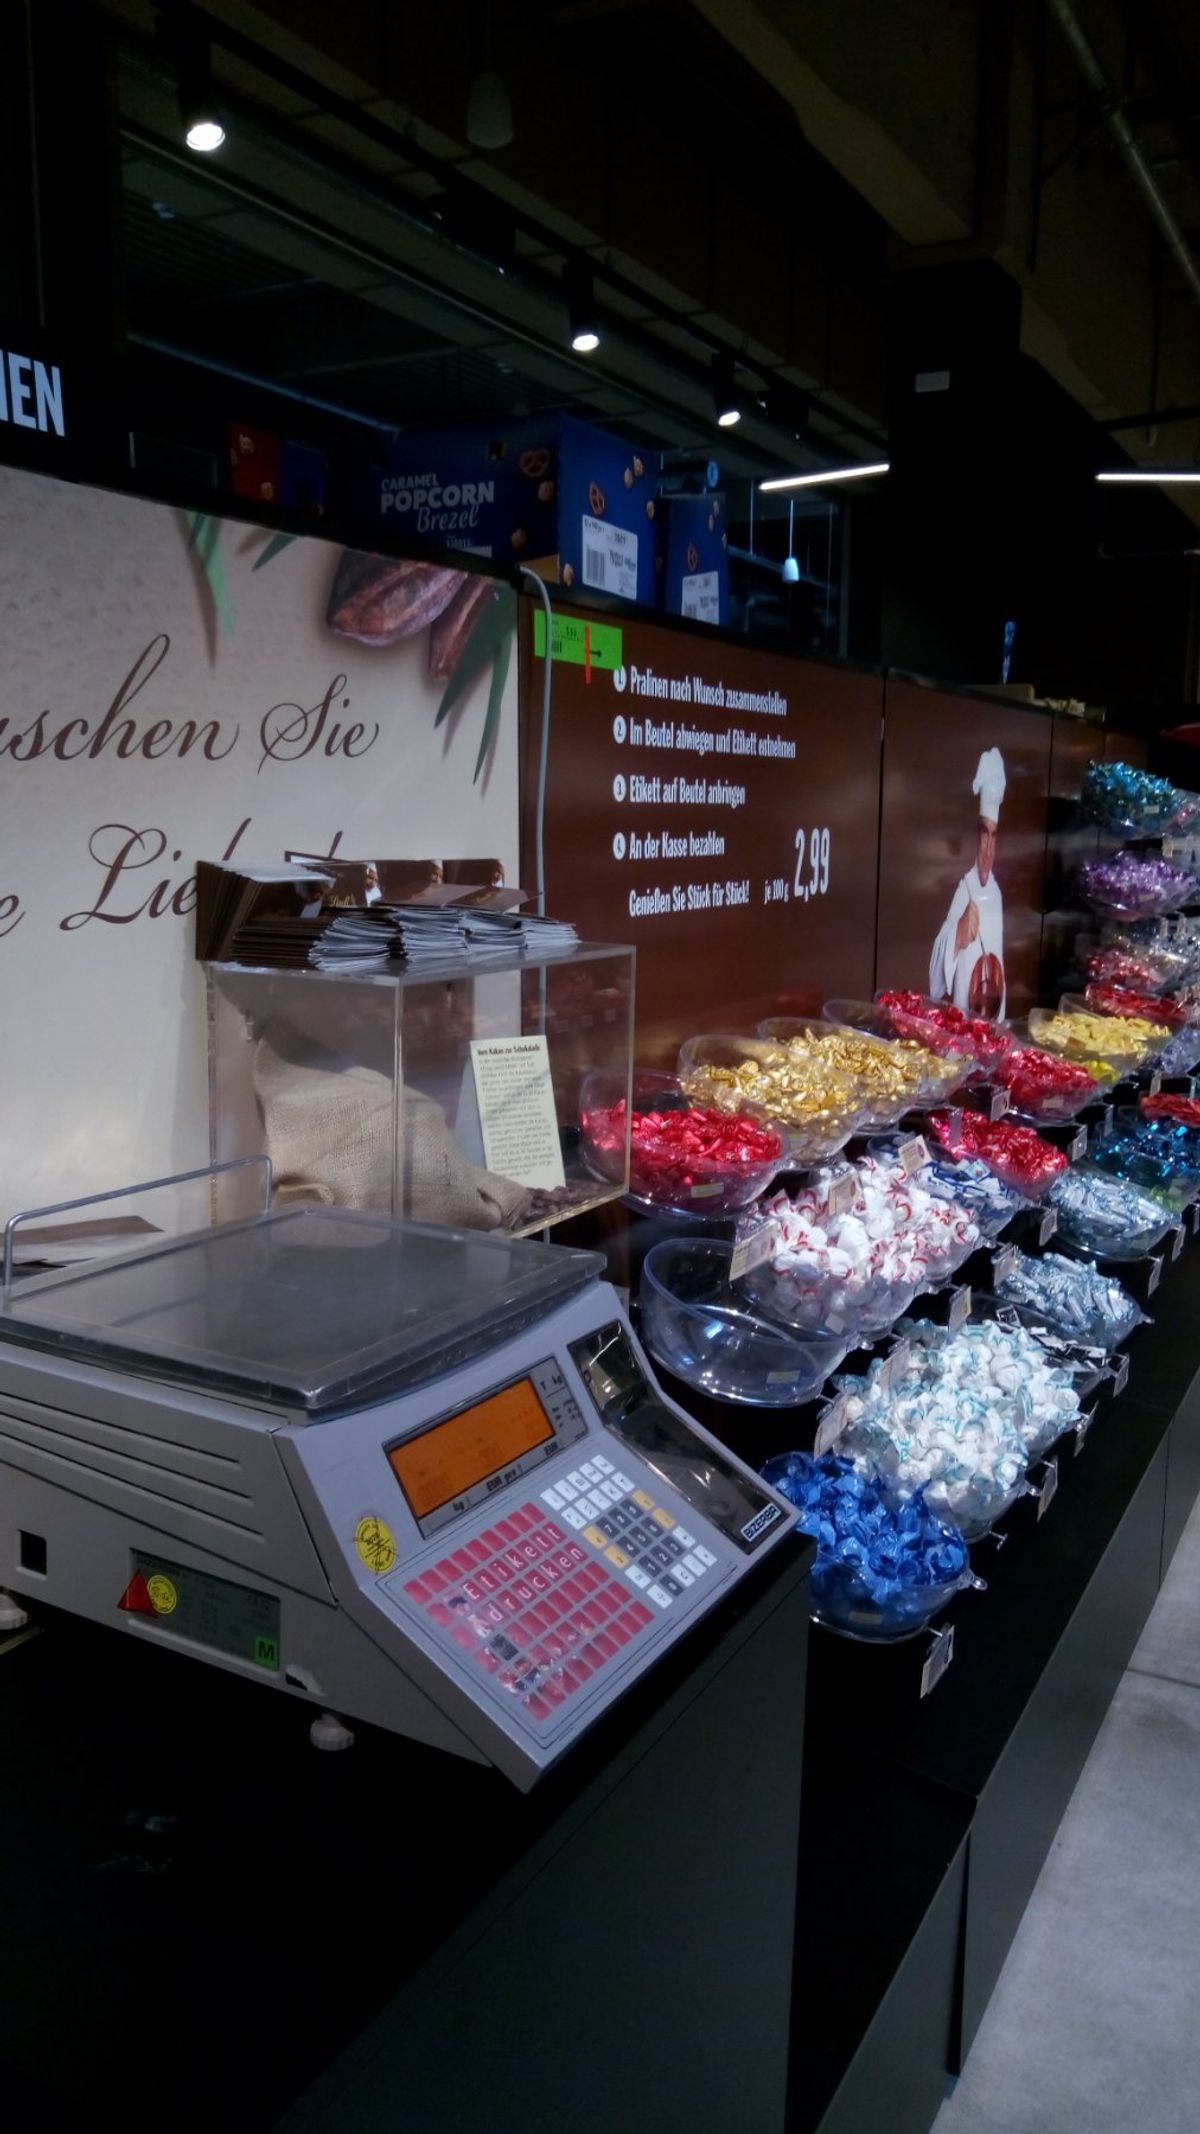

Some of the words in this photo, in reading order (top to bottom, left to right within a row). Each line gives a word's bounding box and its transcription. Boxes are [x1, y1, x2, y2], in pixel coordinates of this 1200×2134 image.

[0, 348, 66, 438] EN
[380, 472, 440, 491] CARAMEL
[380, 480, 495, 514] POPCORN
[416, 502, 481, 532] Brezel
[630, 665, 669, 698] Pralinen
[670, 675, 692, 702] nach
[693, 677, 725, 707] Wunsch
[725, 689, 788, 716] zusammenstellen
[257, 673, 380, 774] Sie
[630, 717, 643, 745] Im
[645, 718, 674, 749] Beutel
[676, 723, 714, 756] abwiegen
[715, 728, 731, 753] und
[732, 729, 757, 756] Etikett
[758, 734, 796, 759] entnehmen
[630, 775, 661, 803] Etikett
[662, 777, 678, 803] auf
[679, 777, 706, 805] Beutel
[707, 780, 746, 809] anbringen
[629, 832, 642, 860] An
[644, 832, 660, 859] der
[662, 831, 688, 859] Kasse
[689, 831, 725, 857] bezahlen
[764, 880, 772, 905] je
[772, 879, 784, 900] 100
[794, 828, 830, 903] 2,99
[629, 887, 671, 917] Genießen
[672, 886, 686, 912] Sie
[687, 883, 711, 910] Stück
[712, 882, 724, 907] für
[725, 879, 750, 905] Stück!
[485, 1476, 504, 1492] EUR
[452, 1500, 466, 1512] kg
[743, 1505, 778, 1539] BIZERBA
[463, 1527, 561, 1600] Etikett
[487, 1547, 584, 1622] drucken
[258, 1641, 274, 1661] M
